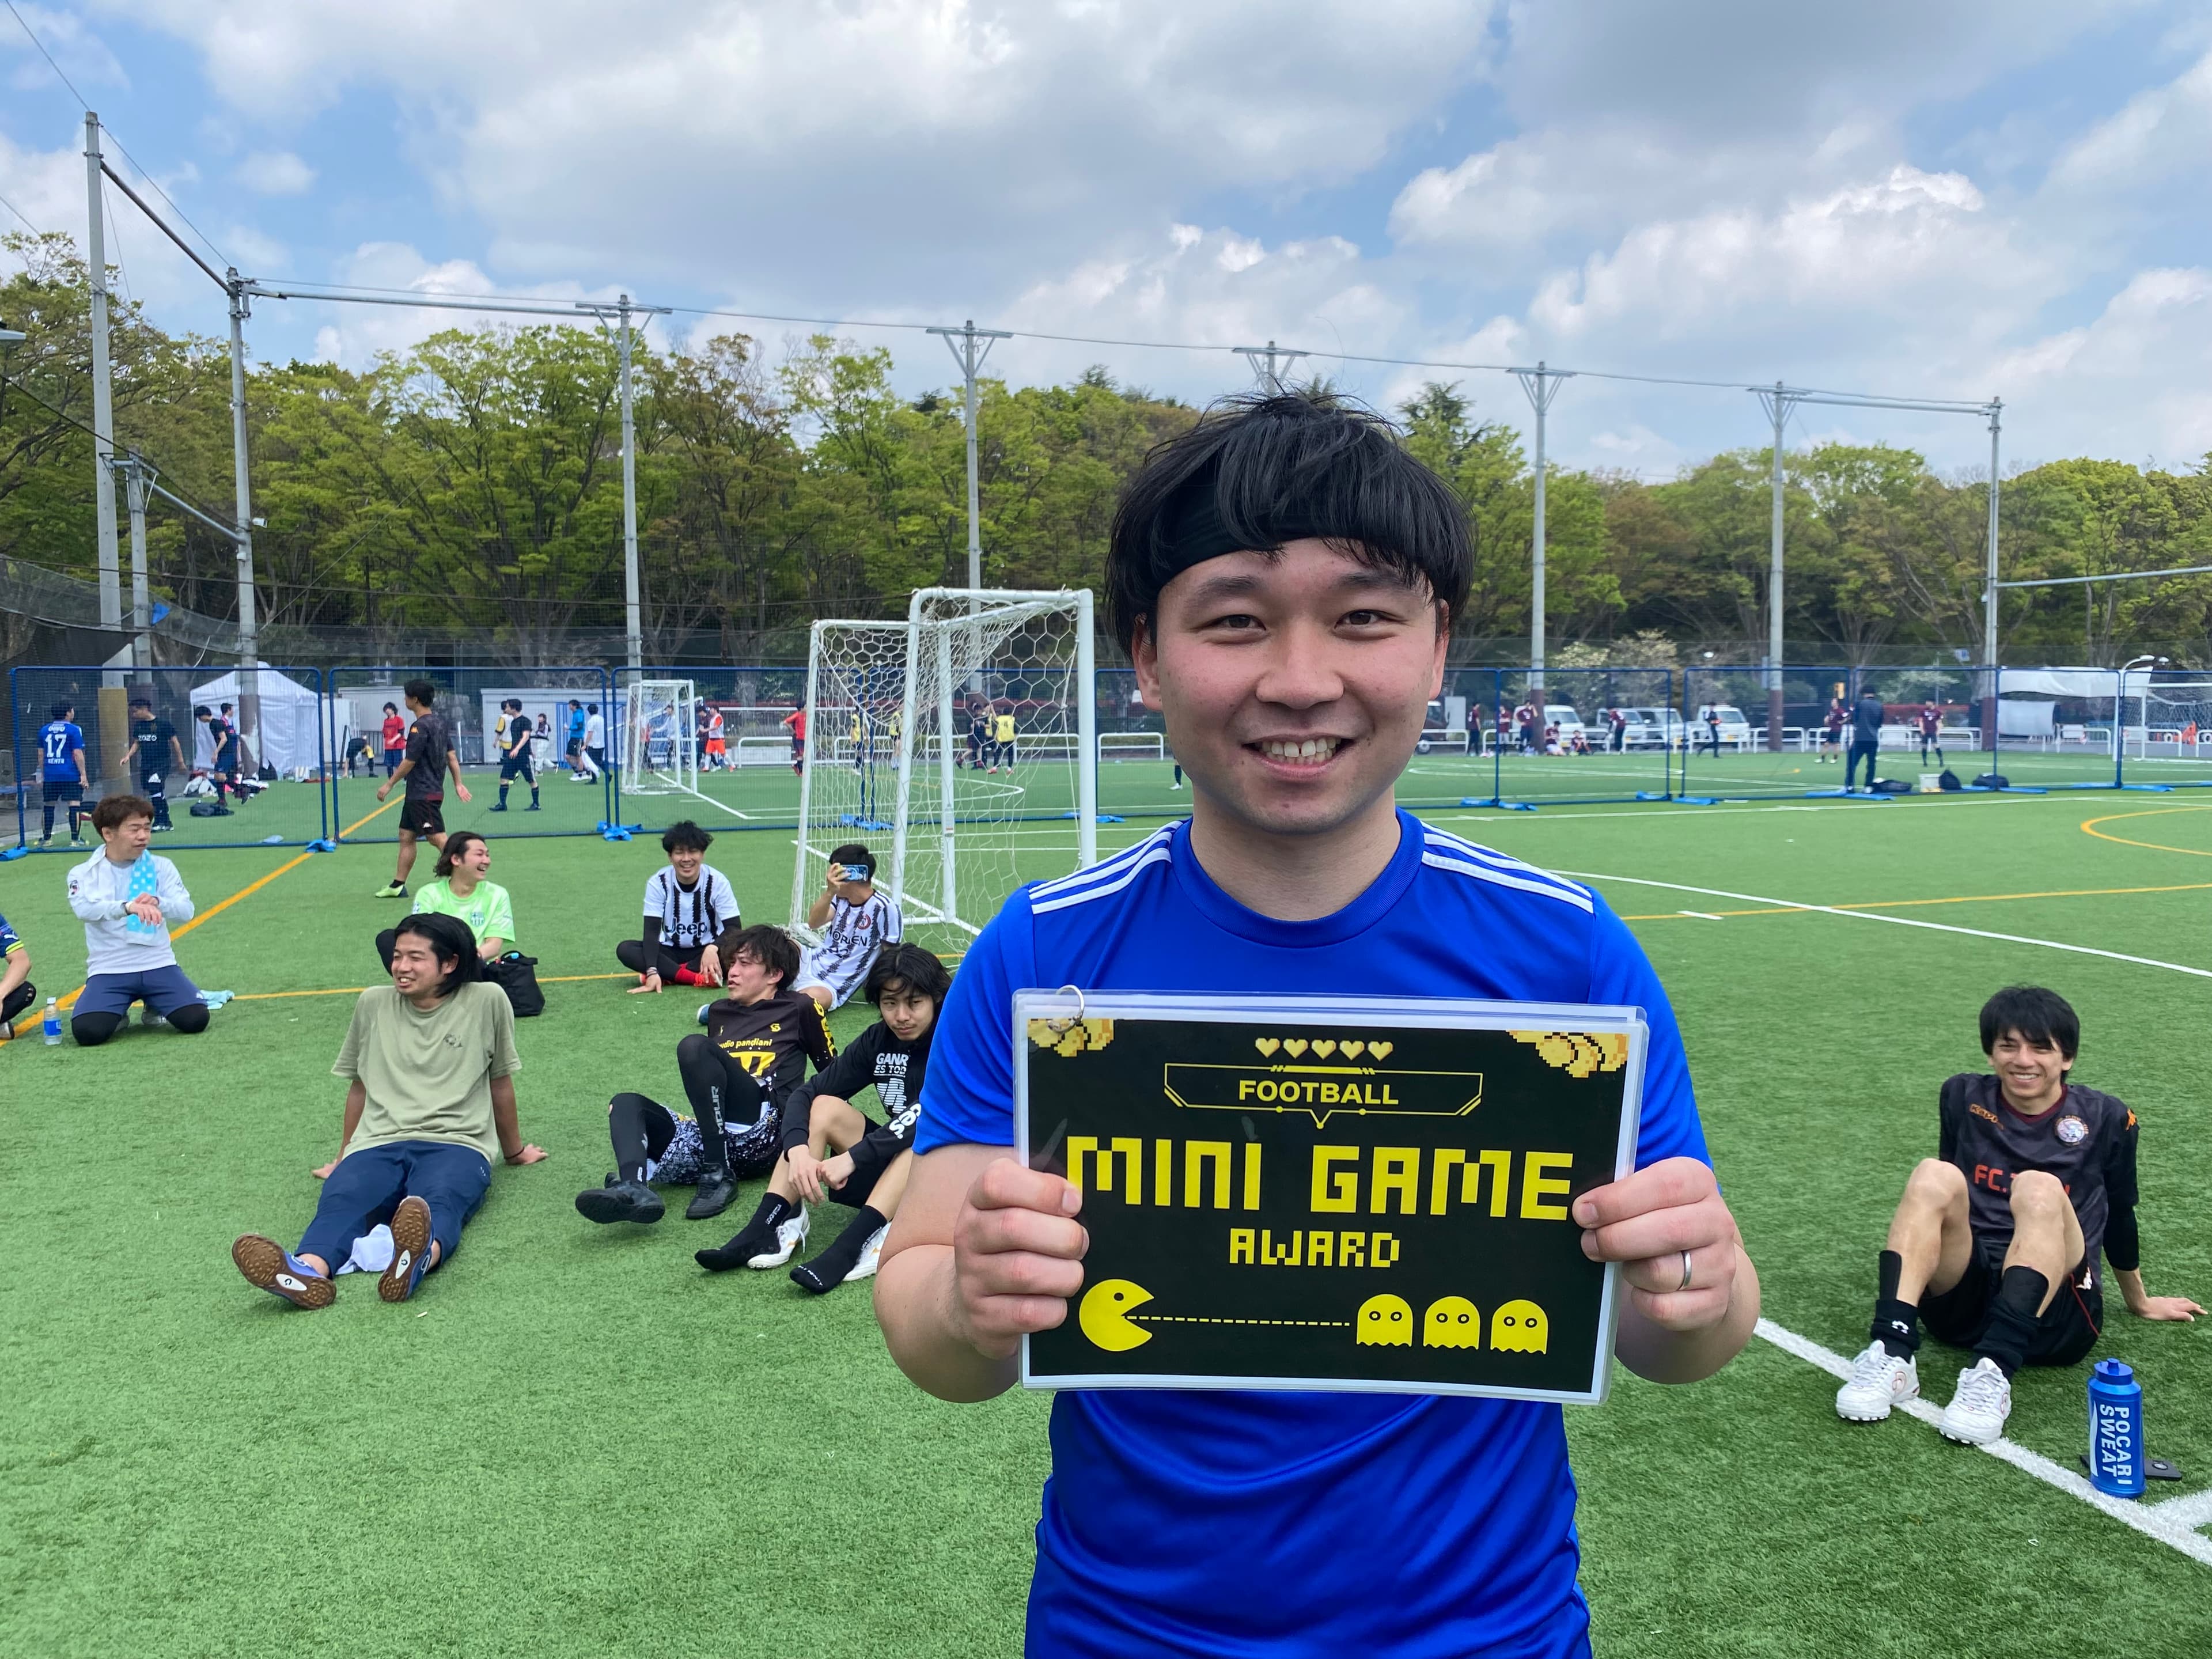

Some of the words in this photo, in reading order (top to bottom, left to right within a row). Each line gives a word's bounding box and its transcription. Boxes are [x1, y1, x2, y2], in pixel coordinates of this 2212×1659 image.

[45, 733, 67, 758] 17
[138, 734, 157, 742] ZOZO
[664, 917, 708, 937] Jeep
[873, 1065, 887, 1074] ES
[1238, 1080, 1399, 1105] FOOTBALL
[1067, 1136, 1262, 1211] MINI
[1310, 1145, 1574, 1221] GAME
[1229, 1228, 1400, 1267] AWARD
[2099, 1404, 2118, 1478] SWEAT
[2114, 1407, 2133, 1485] POCARI
